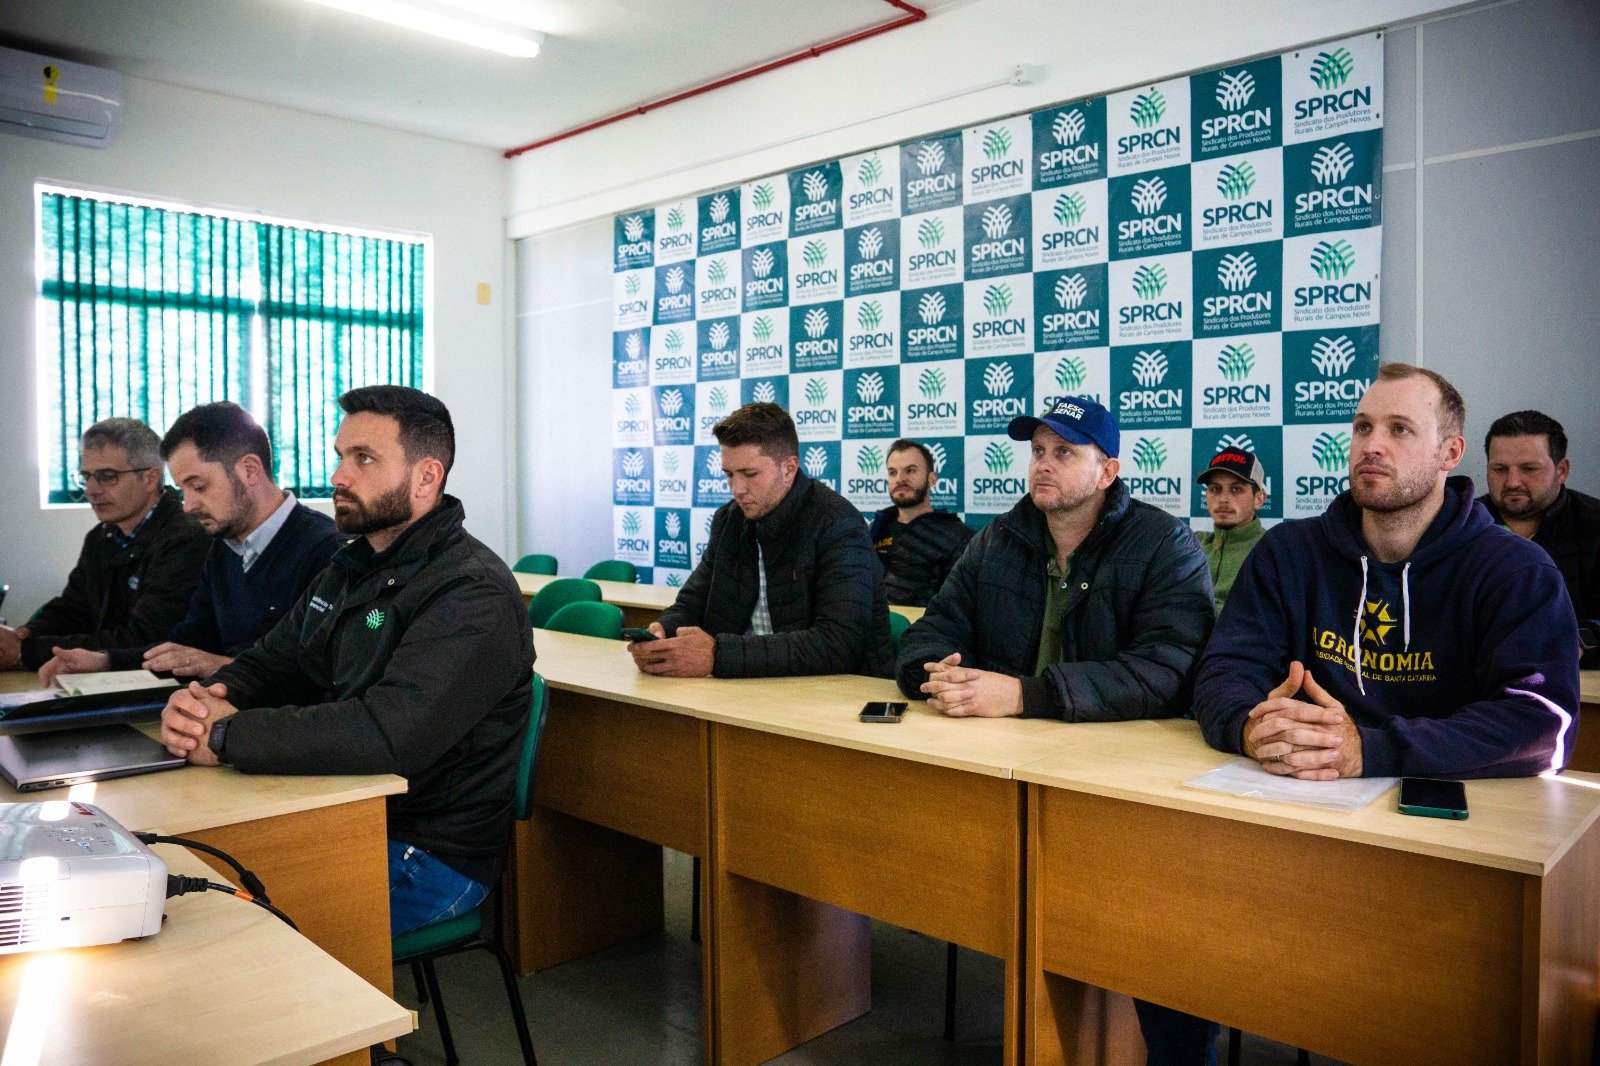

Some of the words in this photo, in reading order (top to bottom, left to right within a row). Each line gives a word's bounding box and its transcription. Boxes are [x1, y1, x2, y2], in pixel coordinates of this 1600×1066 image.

[1294, 86, 1370, 120] SPRCN
[1202, 108, 1271, 138] SPRCN
[1295, 119, 1322, 127] Sindicato
[1336, 109, 1371, 119] Produtores
[1325, 120, 1348, 129] Campos
[1118, 127, 1180, 154] SPRCN
[1040, 143, 1098, 170] SPRCN
[971, 160, 1023, 184] SPRCN
[908, 173, 955, 198] SPRCN
[850, 188, 893, 210] SPRCN
[1295, 184, 1372, 213] SPRCN
[796, 200, 836, 220] SPRCN
[1203, 200, 1272, 226] SPRCN
[1295, 213, 1322, 221] Sindicato
[1336, 207, 1372, 215] Produtores
[747, 212, 782, 230] SPRCN
[1118, 213, 1181, 239] SPRCN
[703, 222, 736, 240] SPRCN
[1042, 226, 1099, 250] SPRCN
[618, 243, 650, 258] SPRCN
[660, 233, 692, 250] SPRCN
[971, 238, 1024, 260] SPRCN
[909, 250, 956, 270] SPRCN
[796, 269, 837, 288] SPRCN
[850, 259, 893, 280] SPRCN
[701, 287, 736, 303] SPRCN
[746, 278, 783, 296] SPRCN
[1294, 282, 1371, 306] SPRCN
[620, 301, 647, 316] SPRCN
[659, 294, 690, 310] SPRCN
[1204, 291, 1271, 316] SPRCN
[1043, 310, 1100, 332] SPRCN
[1119, 302, 1182, 324] SPRCN
[908, 325, 957, 345] SPRCN
[973, 319, 1025, 338] SPRCN
[795, 339, 837, 358] SPRCN
[850, 332, 893, 350] SPRCN
[701, 351, 736, 367] SPRCN
[746, 345, 782, 362] SPRCN
[656, 356, 691, 370] SPRCN
[1120, 389, 1182, 410] SPRCN
[1204, 384, 1270, 405] SPRCN
[848, 406, 894, 422] SPRCN
[908, 402, 957, 420] SPRCN
[973, 398, 1025, 416] SPRCN
[1053, 408, 1082, 420] SENAR
[1057, 402, 1085, 414] FAESC
[655, 419, 690, 431] SPRCN
[796, 410, 836, 424] SPRCN
[616, 480, 650, 492] SPRCN
[660, 480, 686, 492] SPRCN
[698, 480, 729, 493] SPRC
[974, 478, 1026, 494] SPRCN
[1296, 476, 1350, 495] SPRC
[618, 539, 649, 551] SPRCN
[659, 540, 687, 555] SPRCN
[1372, 672, 1382, 681] DE
[1384, 674, 1406, 682] SANTA
[1408, 674, 1436, 682] CATARINA
